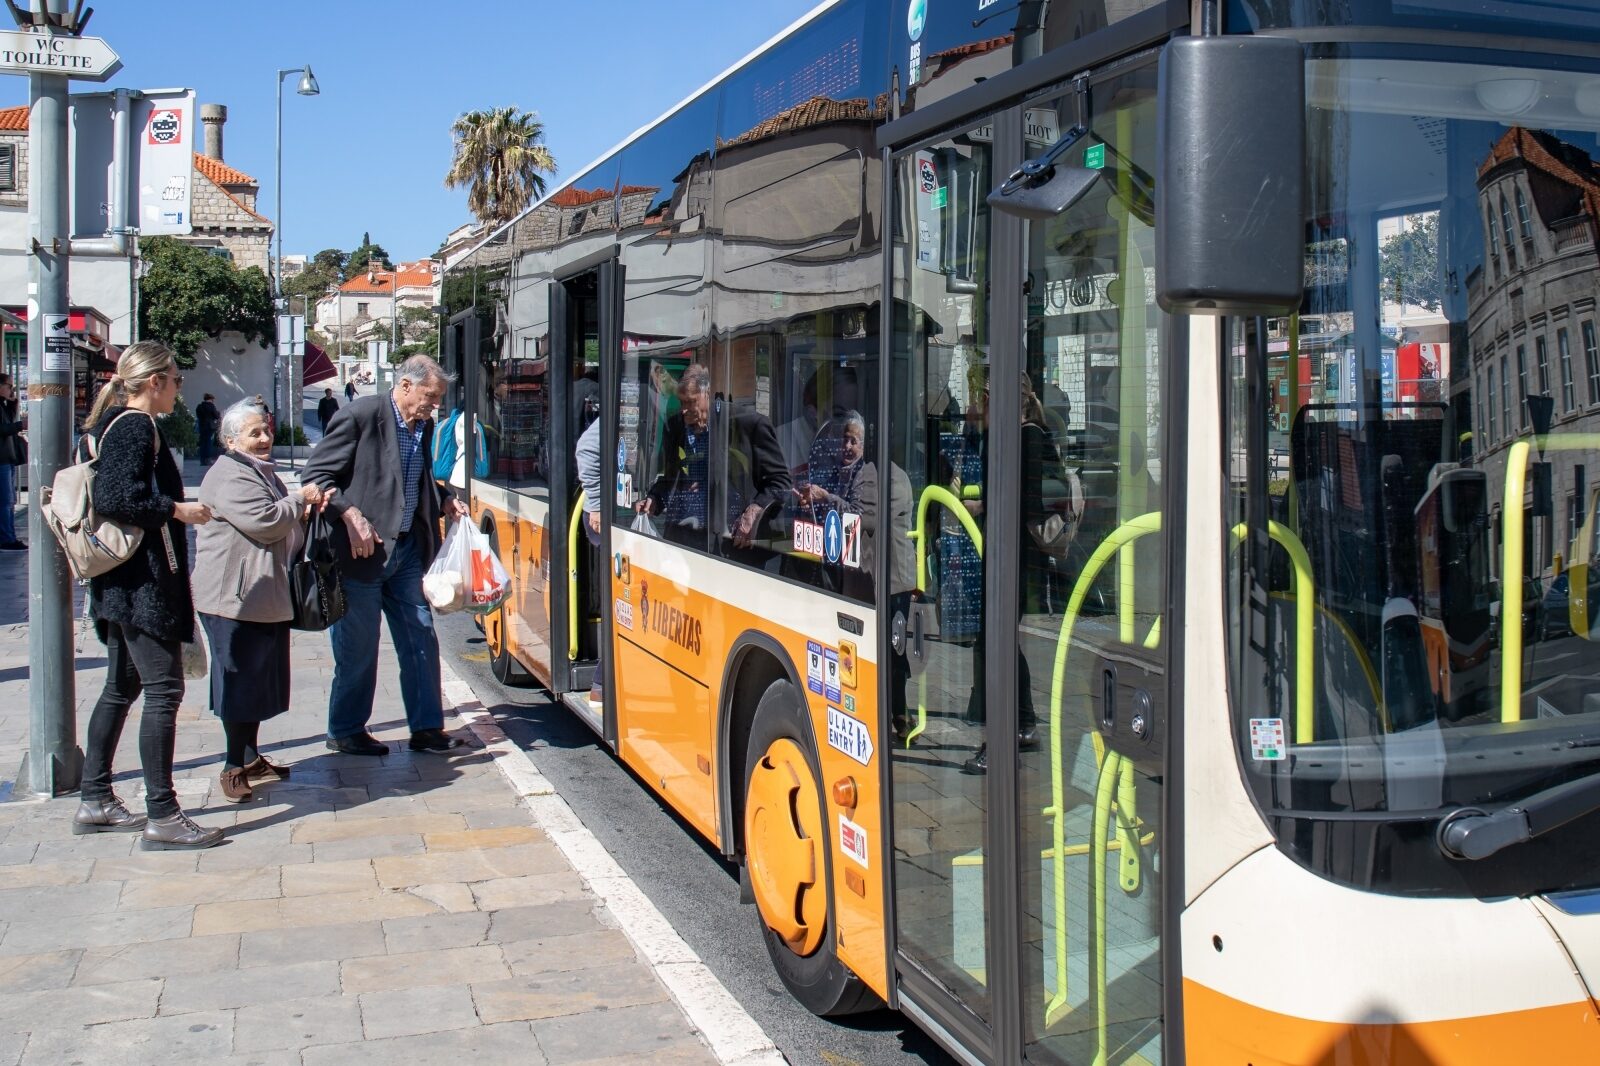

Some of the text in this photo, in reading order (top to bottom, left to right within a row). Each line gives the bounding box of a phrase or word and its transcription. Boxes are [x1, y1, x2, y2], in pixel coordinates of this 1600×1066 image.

[36, 39, 64, 53] WC
[3, 50, 92, 69] TOILETTE
[652, 599, 702, 657] LIBERTAS
[829, 711, 854, 737] ULAZ
[829, 728, 854, 754] ENTRY
